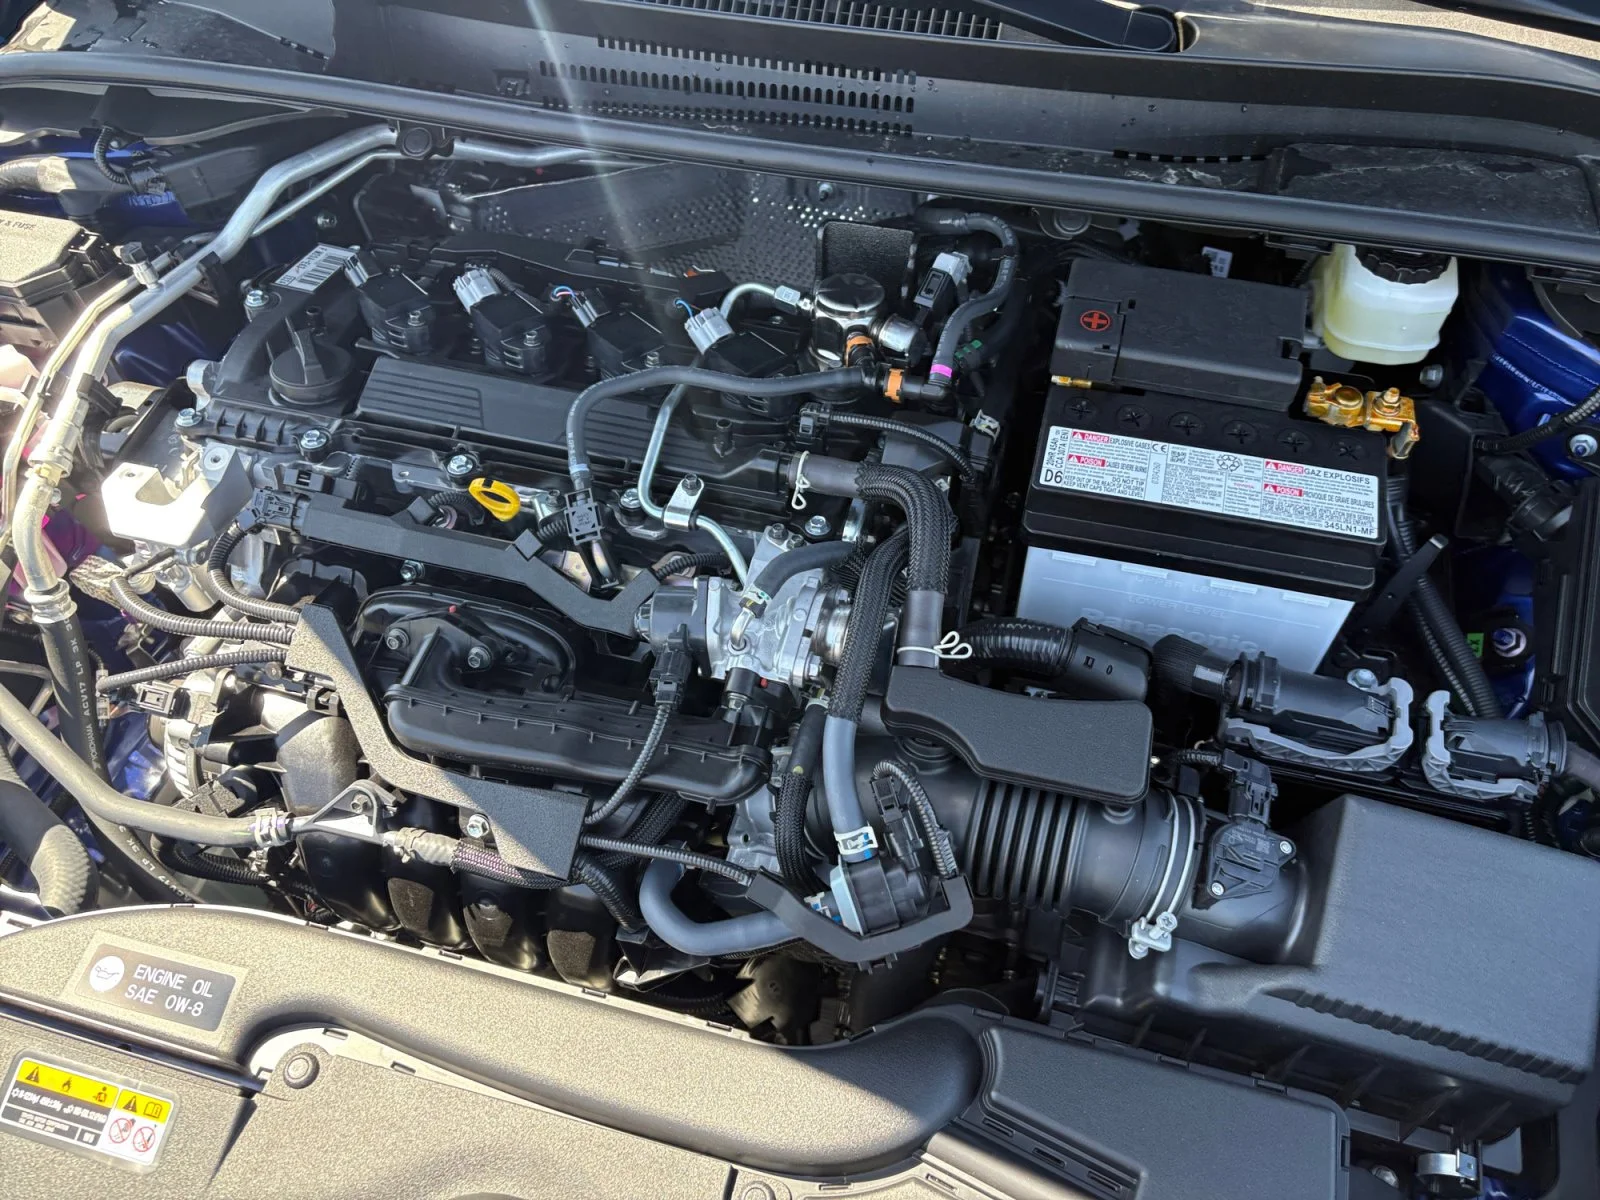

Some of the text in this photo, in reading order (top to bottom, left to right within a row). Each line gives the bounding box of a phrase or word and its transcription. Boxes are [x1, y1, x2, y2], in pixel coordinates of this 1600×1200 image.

[13, 222, 36, 231] FUSE
[1084, 434, 1150, 449] DANGER EXPLOSIVE GASES
[1080, 457, 1102, 466] POISON
[1044, 469, 1063, 484] D6
[1278, 464, 1370, 484] DANGER GAZ EXPLOSIFS
[1122, 483, 1144, 492] CHILDREN
[1128, 489, 1143, 497] LEVEL
[1276, 486, 1299, 495] POISON
[1304, 490, 1327, 501] PROVOQUE
[1324, 521, 1375, 535] 345LN1-MF
[1128, 596, 1227, 619] LOWER LEVEL
[1081, 607, 1260, 653] Panasonic
[70, 638, 79, 654] 3K
[75, 661, 84, 675] LP
[79, 682, 90, 716] ACV17
[86, 724, 98, 760] YOKOHAMA
[126, 838, 140, 853] 3K
[142, 858, 156, 871] LP
[134, 963, 214, 998] ENGINE OIL
[124, 984, 205, 1017] SAE 0W-8
